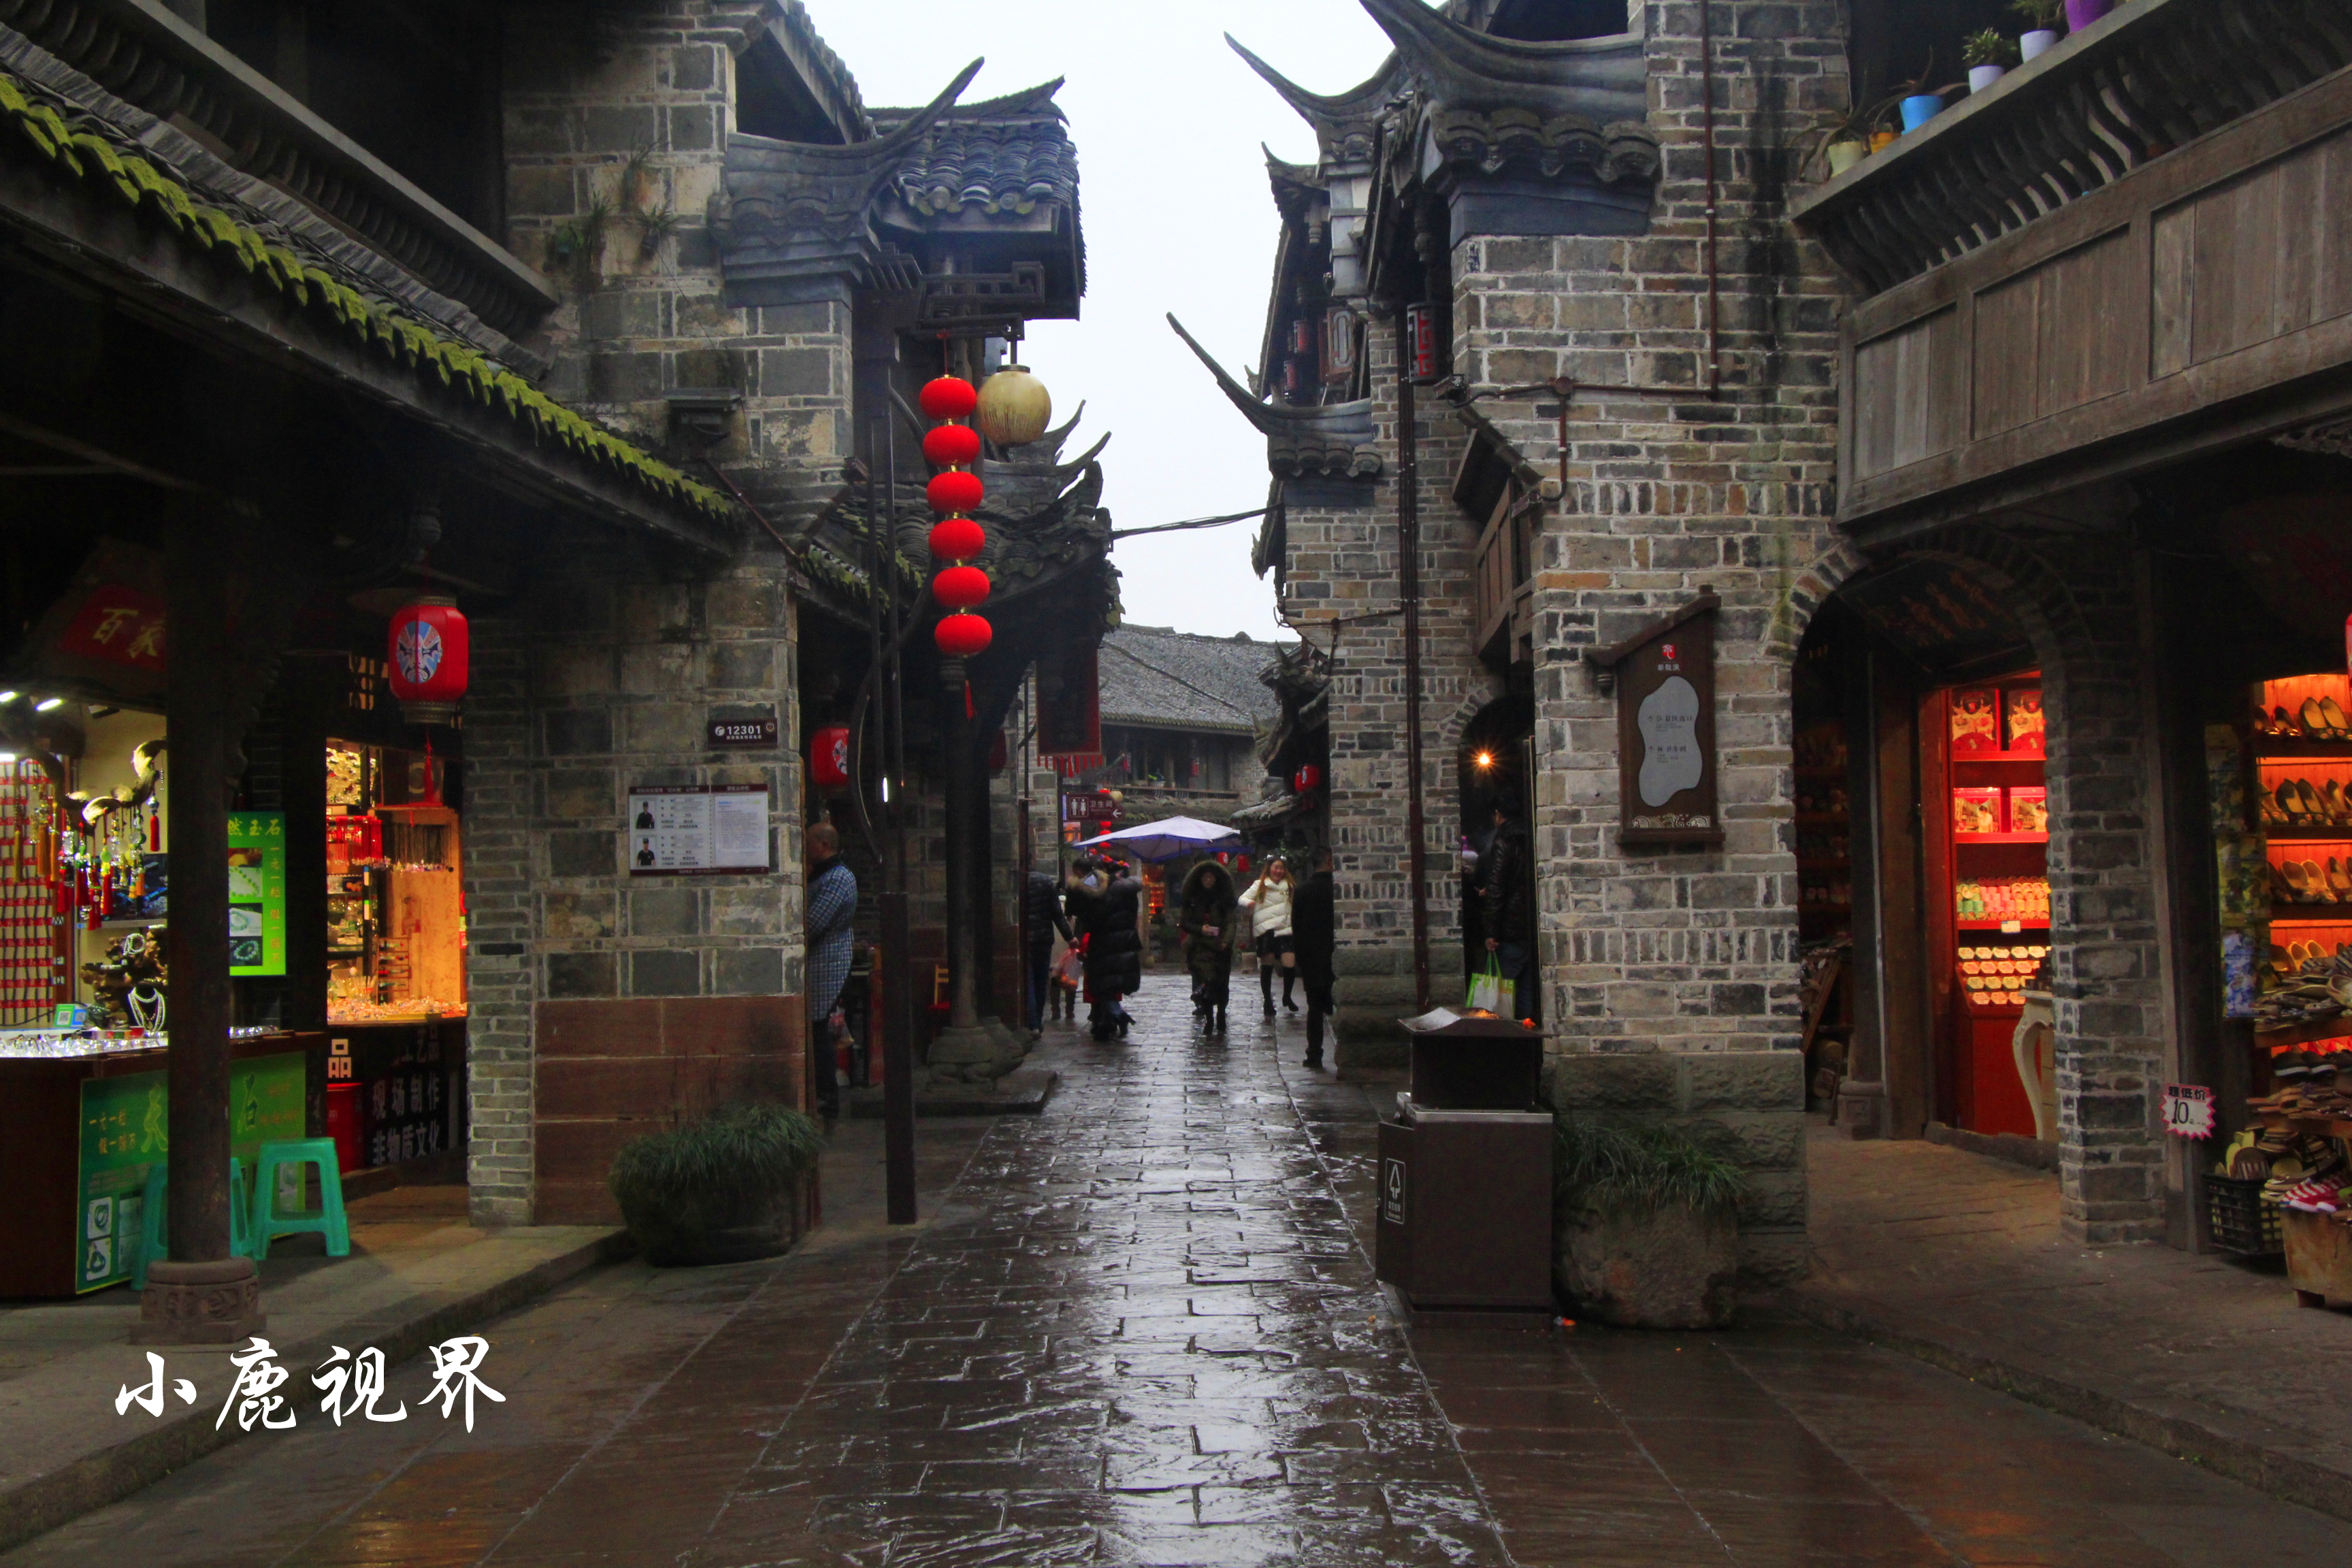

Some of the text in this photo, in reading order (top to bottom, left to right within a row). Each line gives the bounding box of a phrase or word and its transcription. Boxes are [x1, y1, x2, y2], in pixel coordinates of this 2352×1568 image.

[727, 725, 760, 735] 12301
[328, 1039, 352, 1078] 品
[373, 1068, 440, 1120] 现场制作
[2168, 1086, 2205, 1100] 超低价
[373, 1119, 441, 1165] 非物质文化
